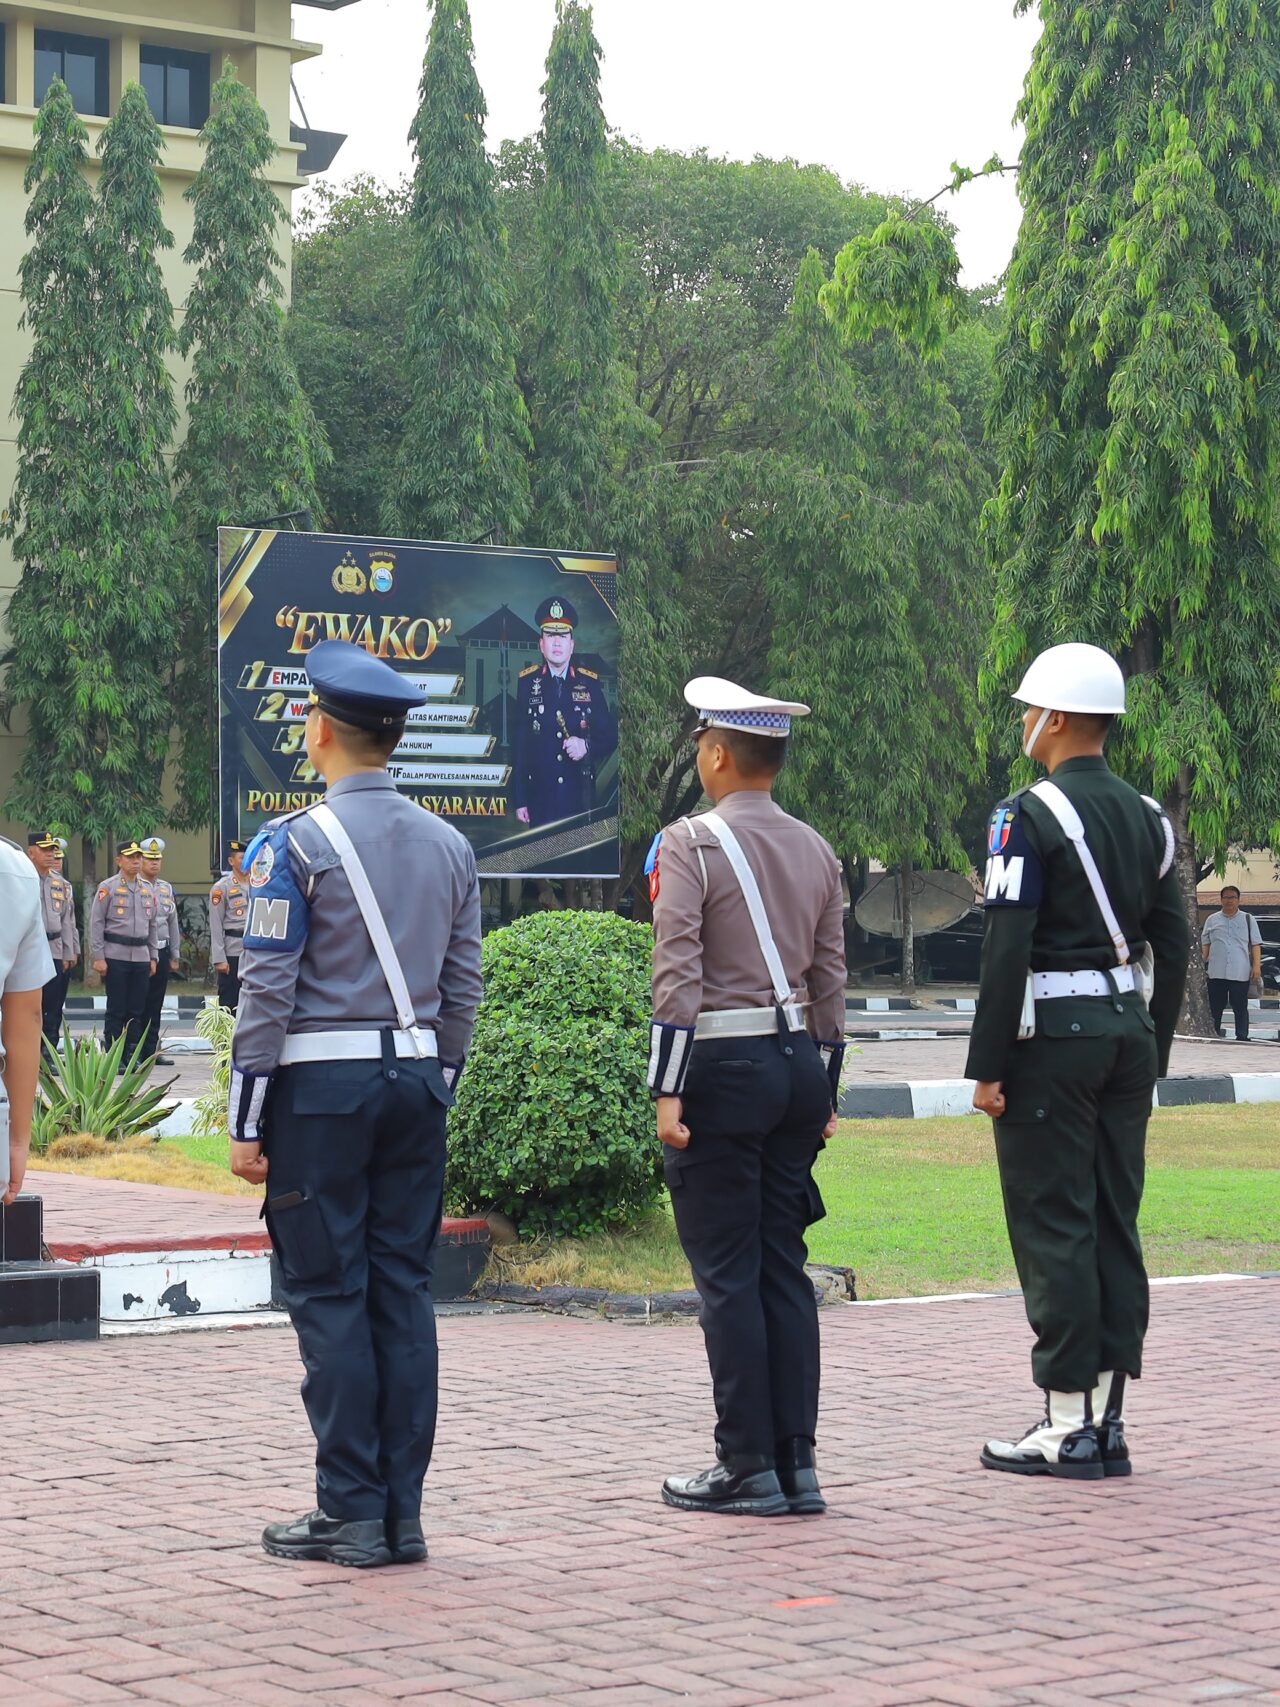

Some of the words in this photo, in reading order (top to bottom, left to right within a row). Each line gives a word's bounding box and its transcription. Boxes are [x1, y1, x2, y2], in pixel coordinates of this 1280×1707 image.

[246, 660, 266, 689] 1
[272, 671, 313, 686] EMPA
[258, 692, 285, 721] 2
[409, 742, 433, 750] HUKUM
